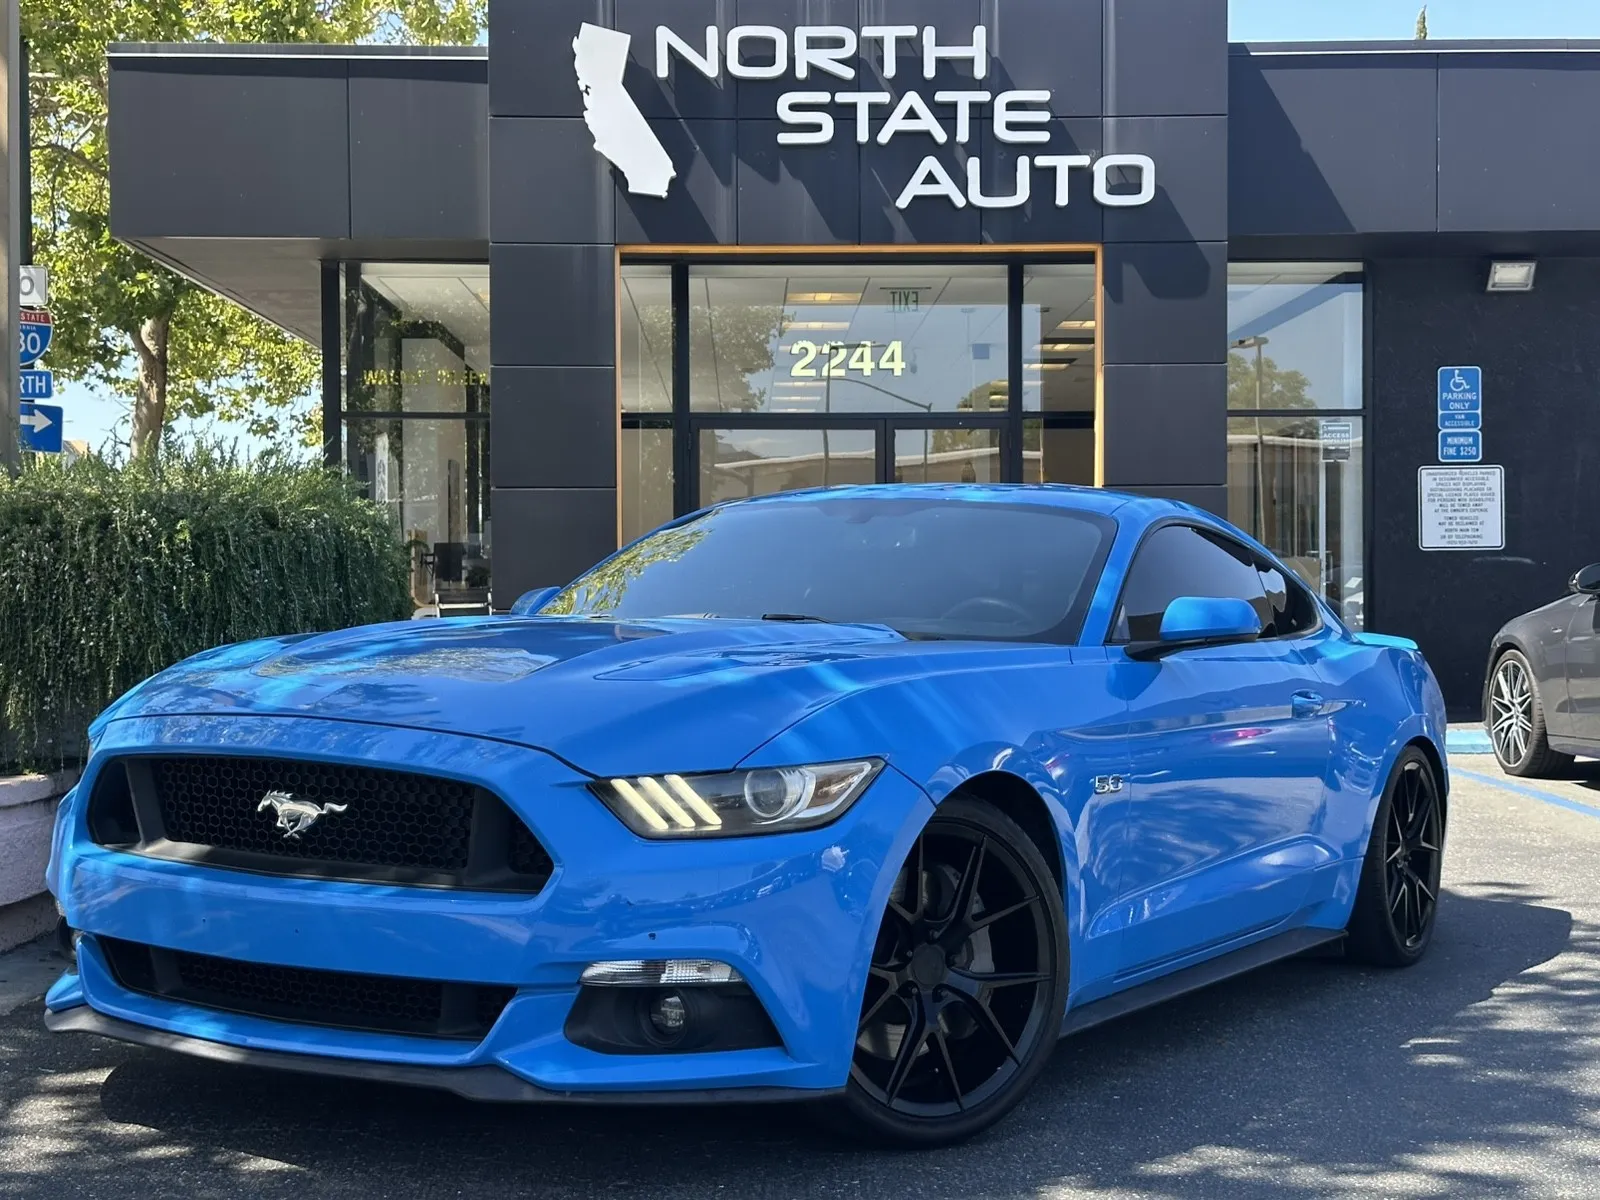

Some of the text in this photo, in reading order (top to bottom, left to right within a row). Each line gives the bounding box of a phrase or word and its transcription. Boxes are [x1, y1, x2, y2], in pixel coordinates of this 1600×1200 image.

[655, 24, 988, 80] NORTH
[776, 90, 1051, 145] STATE
[895, 154, 1156, 208] AUTO
[20, 275, 35, 296] O
[20, 313, 46, 322] STATE
[790, 340, 906, 377] 2244
[1442, 392, 1477, 400] PARKING
[1449, 402, 1470, 410] ONLY
[1446, 436, 1473, 445] MINIMUM
[1443, 446, 1477, 456] FINE $250
